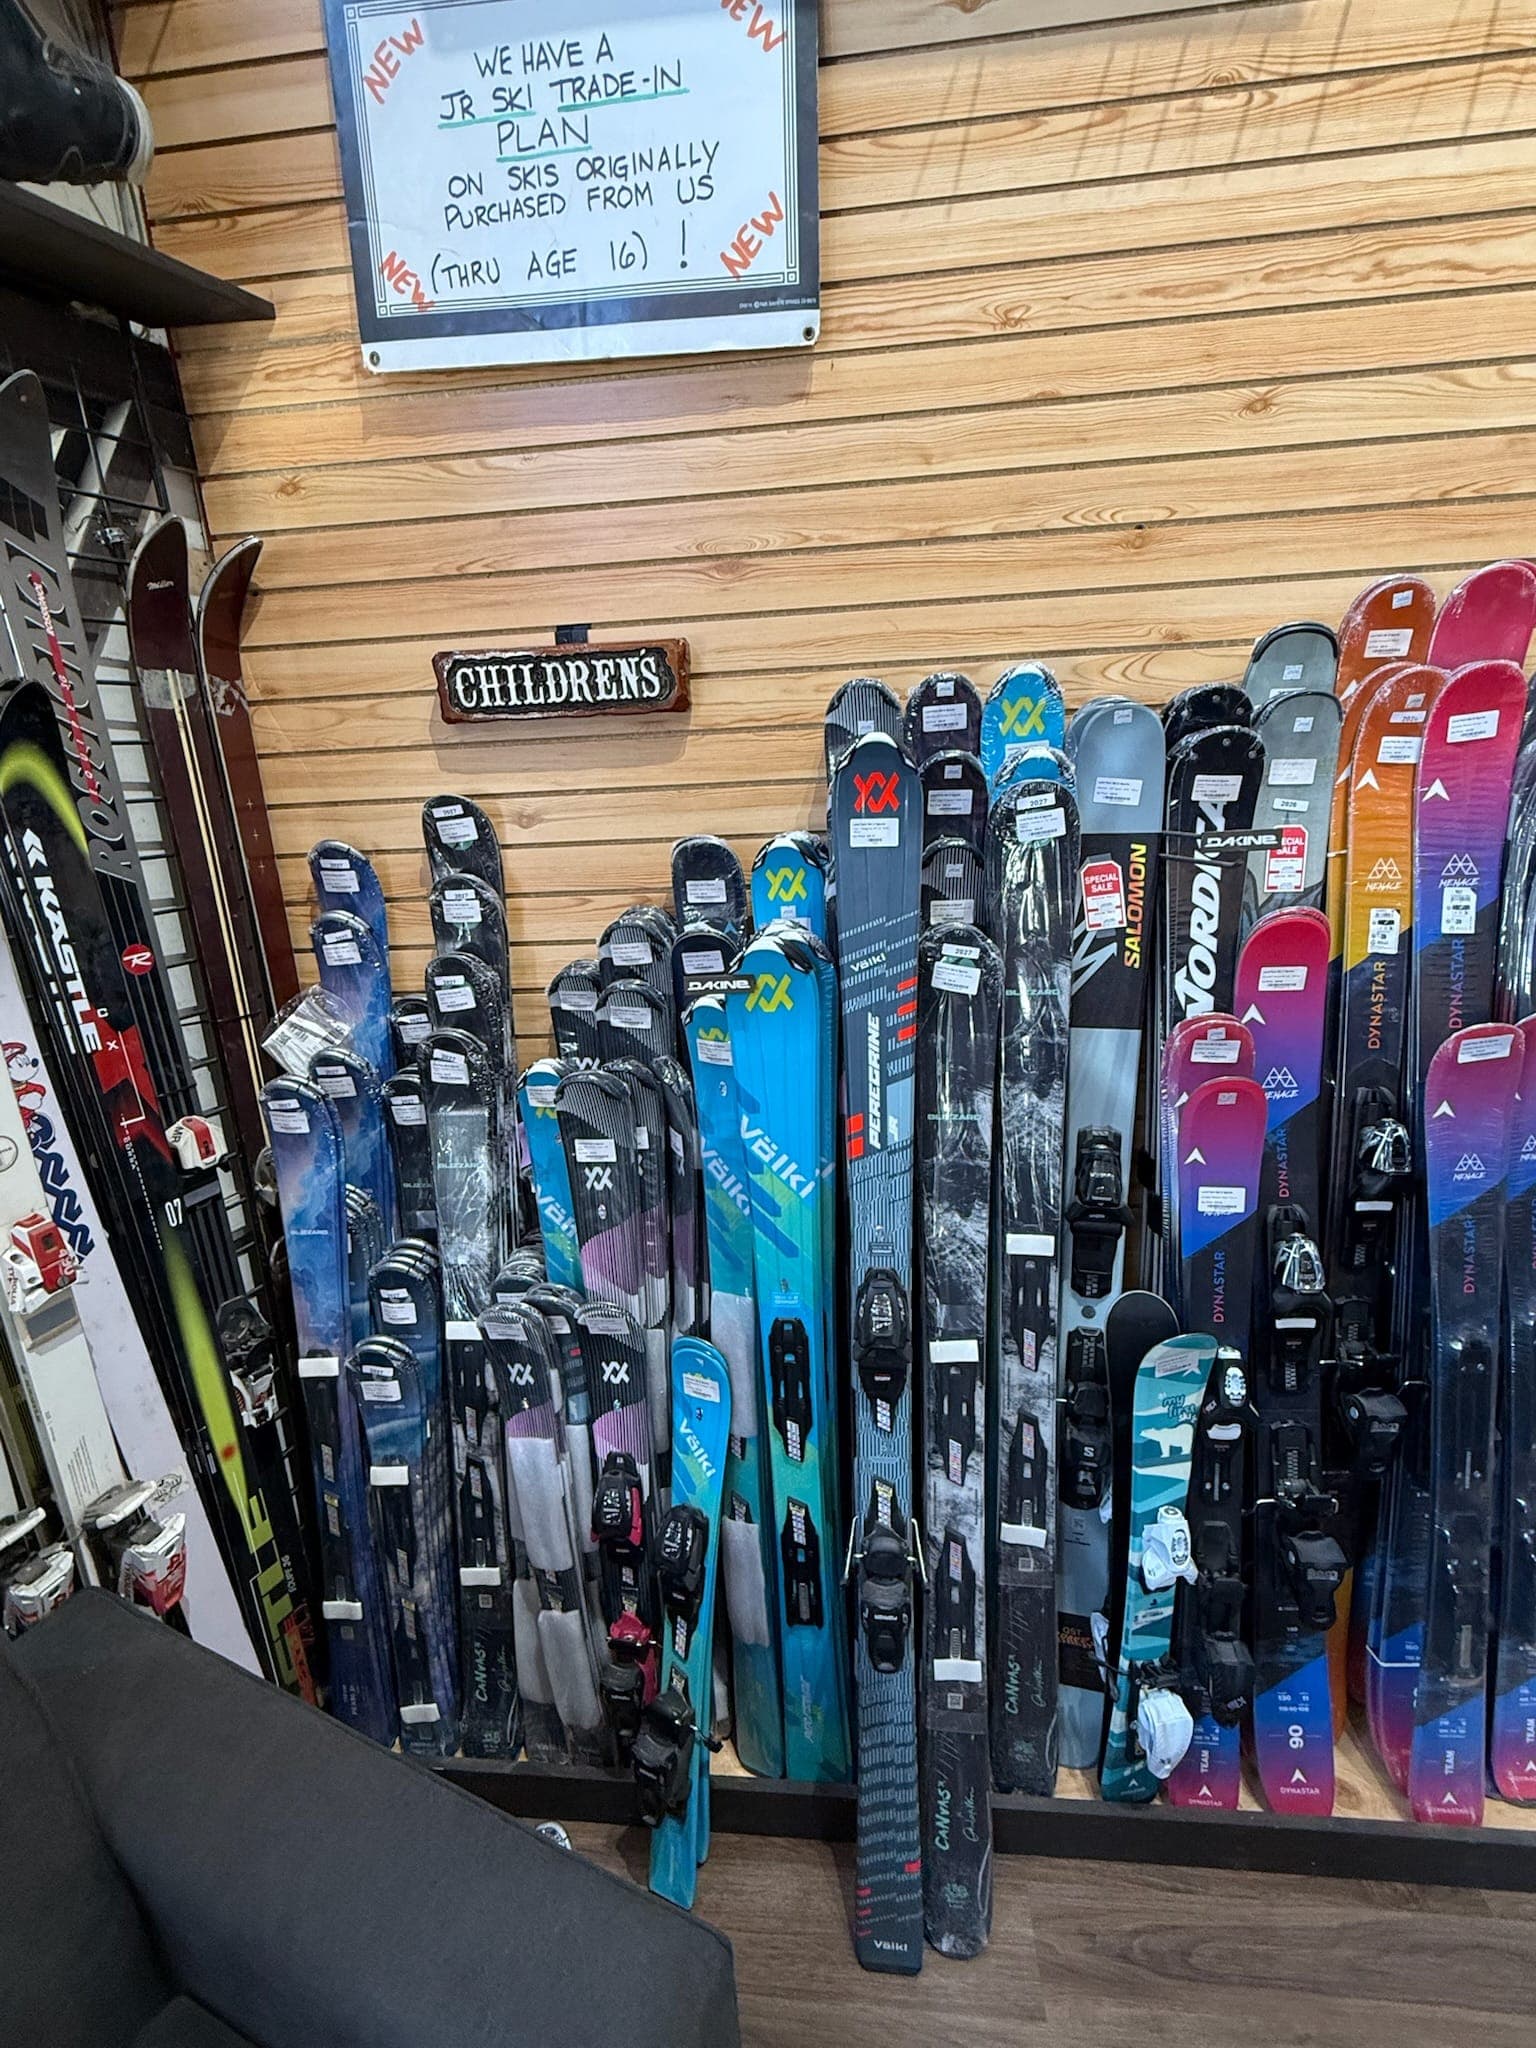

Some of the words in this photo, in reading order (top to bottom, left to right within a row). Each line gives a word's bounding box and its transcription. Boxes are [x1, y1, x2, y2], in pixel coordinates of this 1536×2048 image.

[362, 17, 425, 105] NEW
[474, 49, 512, 78] WE
[522, 38, 583, 75] HAVE
[595, 32, 613, 64] A
[440, 89, 476, 122] JR
[493, 82, 534, 113] SKI
[549, 59, 682, 104] TRADE-IN
[497, 114, 590, 156] PLAN
[448, 170, 484, 199] ON
[507, 163, 560, 191] SKIS
[576, 139, 720, 183] ORIGINALLY
[445, 192, 567, 232] PURCHASED
[587, 181, 653, 212] FROM
[677, 175, 714, 205] US
[431, 253, 500, 294] (THRU
[527, 248, 578, 281] AGE
[610, 231, 648, 272] 16)
[719, 192, 785, 282] NEW
[379, 250, 437, 314] NEW
[455, 649, 660, 708] CHILDREN'S
[1029, 798, 1047, 807] 2027
[1204, 834, 1279, 848] DAKINE
[1084, 872, 1119, 885] SPECIAL
[1091, 882, 1114, 893] SALE
[1365, 881, 1403, 891] MENACE
[1438, 878, 1480, 889] MENACE
[1124, 843, 1147, 969] SALOMON
[850, 952, 887, 972] Völkl
[954, 947, 973, 956] 2027
[687, 979, 751, 991] DAKINE
[1005, 988, 1061, 997] BLIZZARD
[1367, 961, 1387, 1050] DYNASTAR
[1448, 940, 1465, 1029] DYNASTAR
[868, 1011, 881, 1150] PEREGRINE
[699, 1136, 751, 1217] Völkl
[740, 1113, 816, 1199] Völkl
[1278, 1127, 1288, 1199] DYNASTAR
[1452, 1171, 1487, 1182] MENACE
[164, 1198, 183, 1227] 07
[1463, 1214, 1477, 1294] DYNASTAR
[1213, 1251, 1226, 1323] DYNASTAR
[1161, 1394, 1186, 1408] my
[1167, 1403, 1196, 1419] first
[677, 1418, 717, 1479] Völkl
[474, 1648, 488, 1701] CANVAS
[1005, 1660, 1020, 1714] CANVAS
[1200, 1749, 1210, 1773] TEAM
[1288, 1724, 1305, 1749] 90
[1445, 1750, 1456, 1775] TEAM
[935, 1788, 951, 1851] CANVAS
